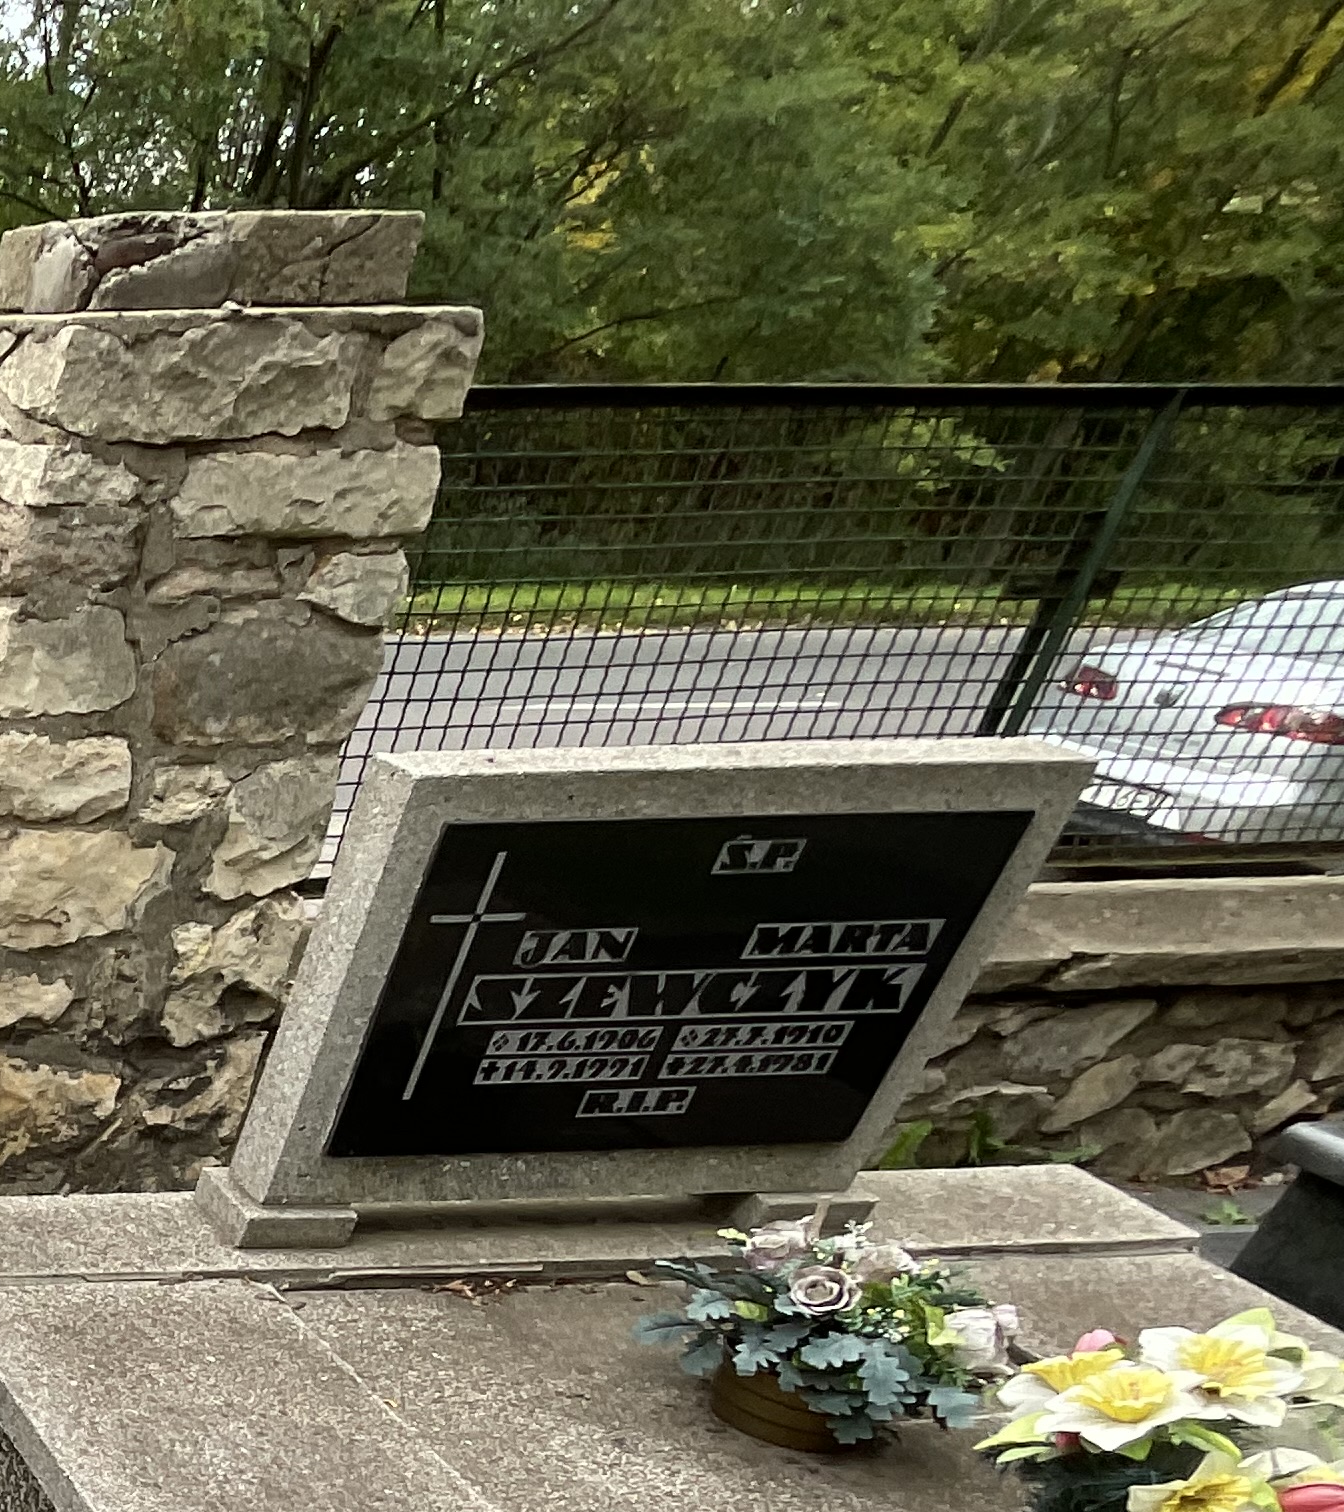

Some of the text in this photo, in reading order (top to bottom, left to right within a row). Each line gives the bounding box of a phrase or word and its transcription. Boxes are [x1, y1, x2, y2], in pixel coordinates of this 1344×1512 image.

[517, 923, 934, 967] JAN MARTA
[460, 967, 912, 1022] SZEWCZYK
[579, 1089, 689, 1115] R.I.P.
